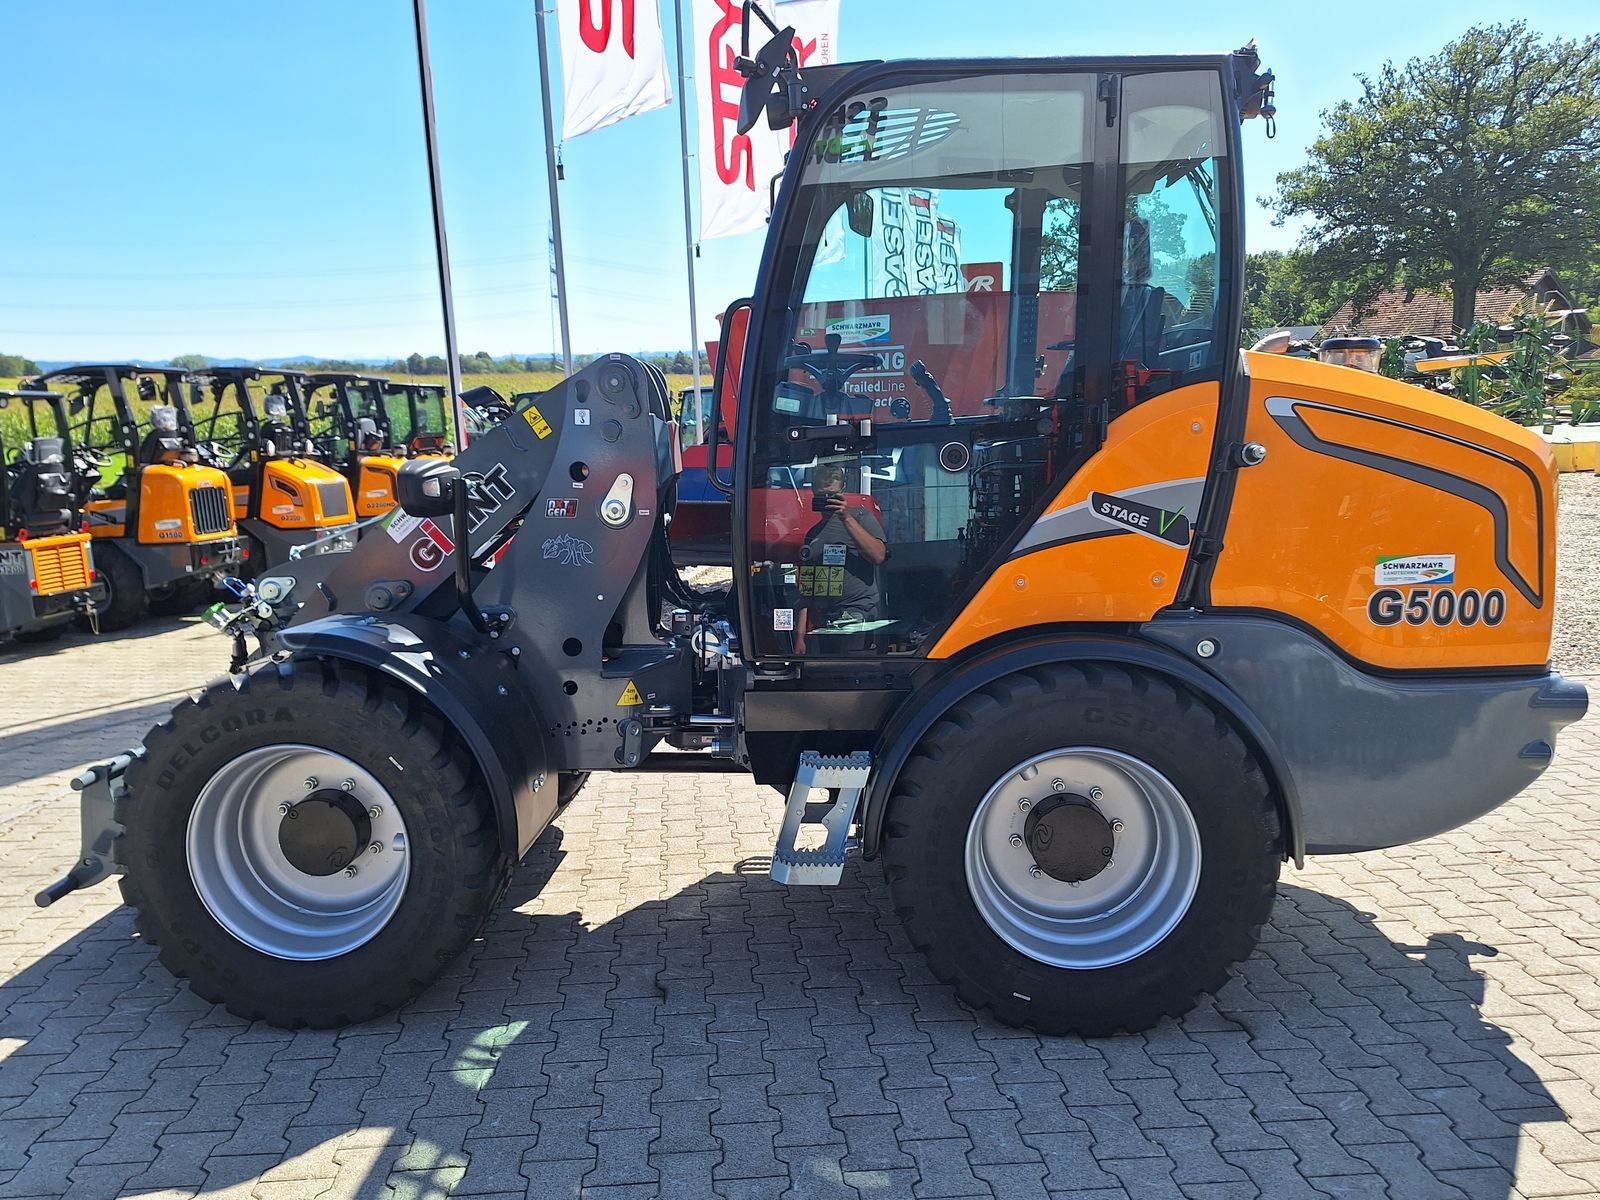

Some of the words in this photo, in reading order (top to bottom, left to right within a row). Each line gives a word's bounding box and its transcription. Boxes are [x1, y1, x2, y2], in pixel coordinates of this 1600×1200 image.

[831, 321, 881, 331] SCHWARZMAYR
[844, 380, 905, 393] TrailedLine
[409, 463, 516, 573] GINT
[1100, 502, 1150, 528] STAGE
[1382, 562, 1444, 570] SCHWARZMAYR
[1366, 588, 1507, 627] G5000
[157, 705, 297, 791] DELCORA
